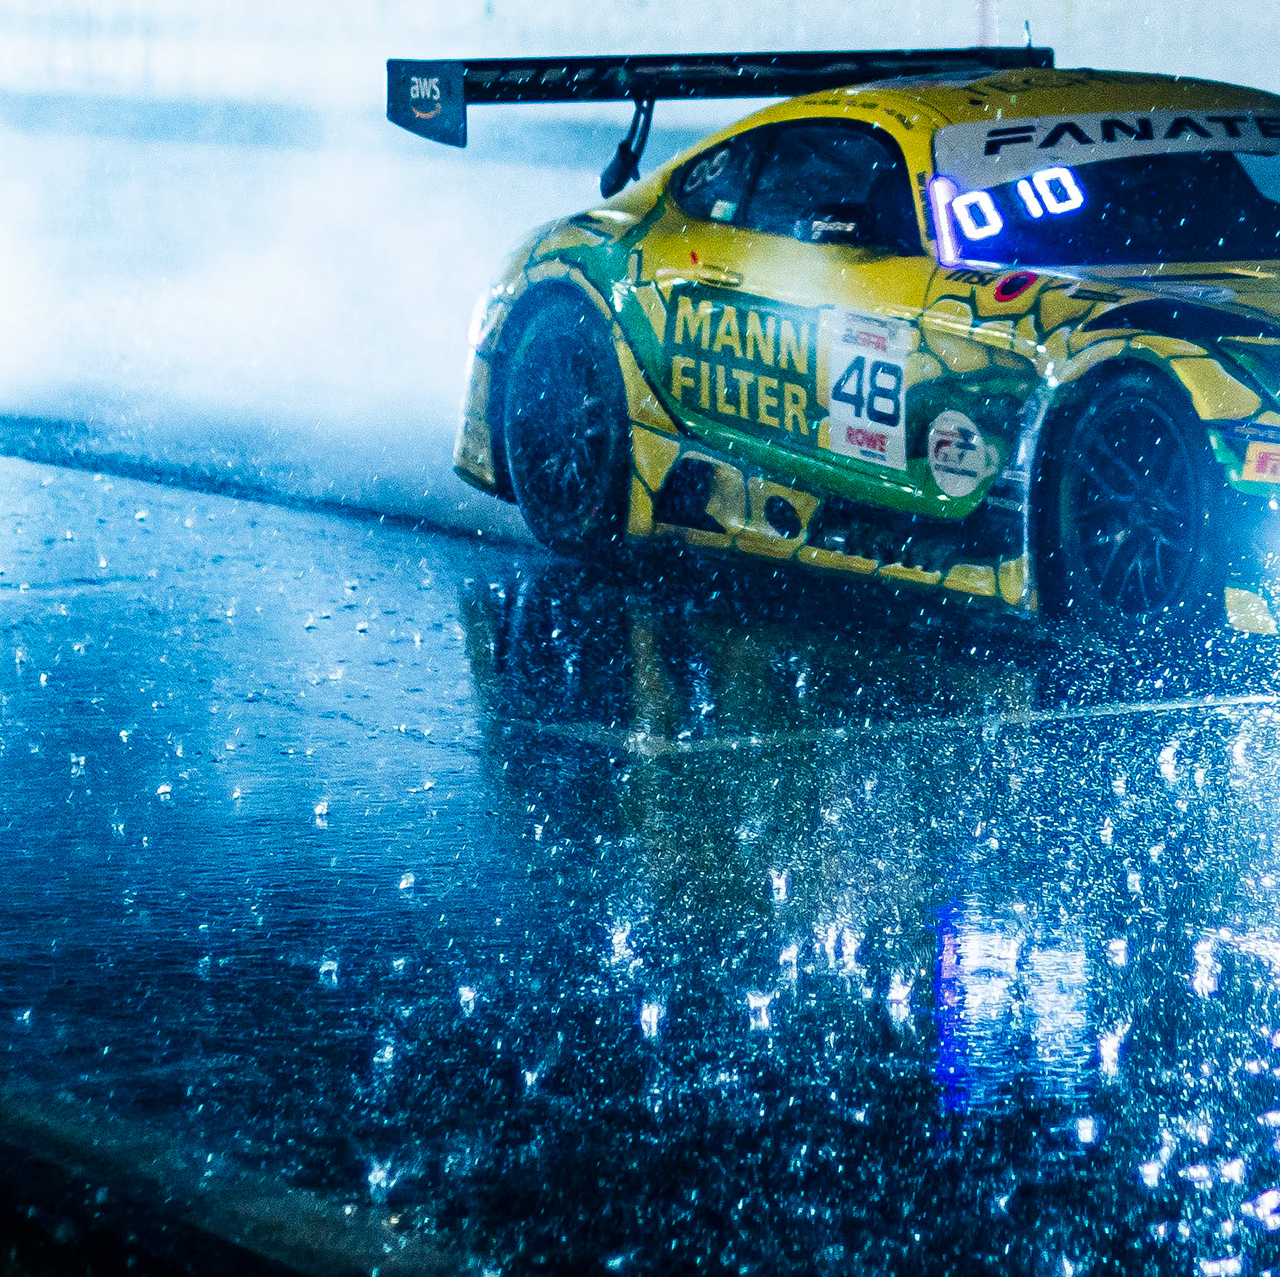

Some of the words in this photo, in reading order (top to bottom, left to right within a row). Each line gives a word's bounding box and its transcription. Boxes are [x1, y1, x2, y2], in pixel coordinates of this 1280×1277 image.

[409, 76, 441, 100] aws
[674, 295, 810, 375] MANN
[671, 355, 810, 436] FILTER
[831, 355, 904, 428] 48
[846, 425, 887, 453] ROWE
